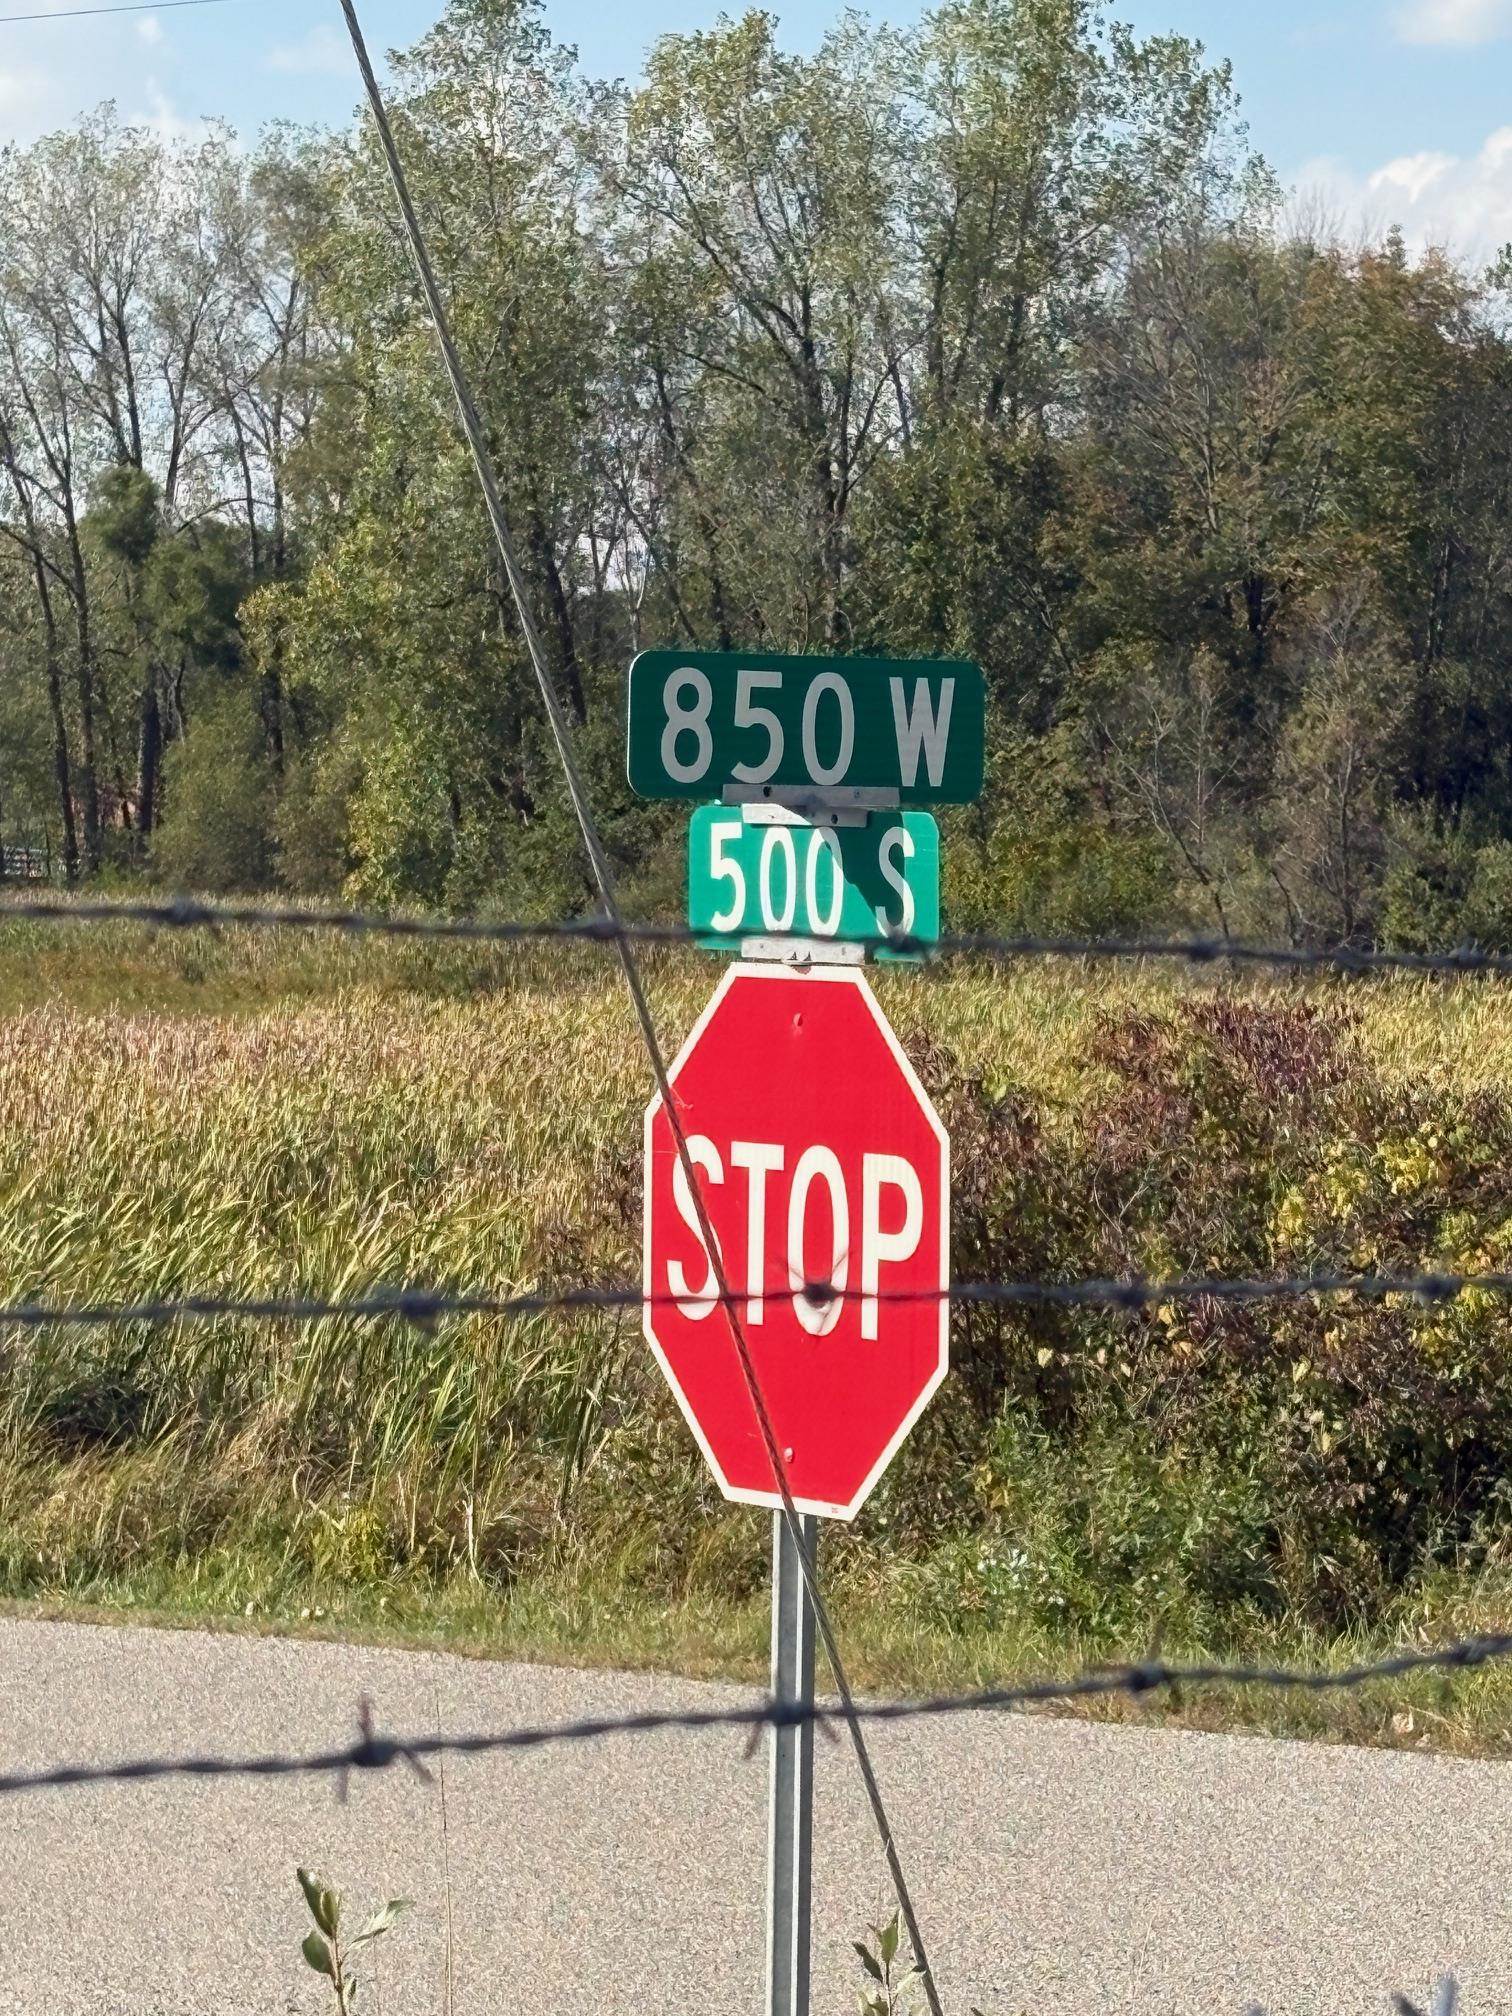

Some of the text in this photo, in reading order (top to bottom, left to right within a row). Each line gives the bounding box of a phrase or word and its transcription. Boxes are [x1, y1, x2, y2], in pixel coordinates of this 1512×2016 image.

[661, 667, 955, 787] 850 W
[710, 821, 915, 940] 500 S
[667, 1134, 924, 1341] STOP
